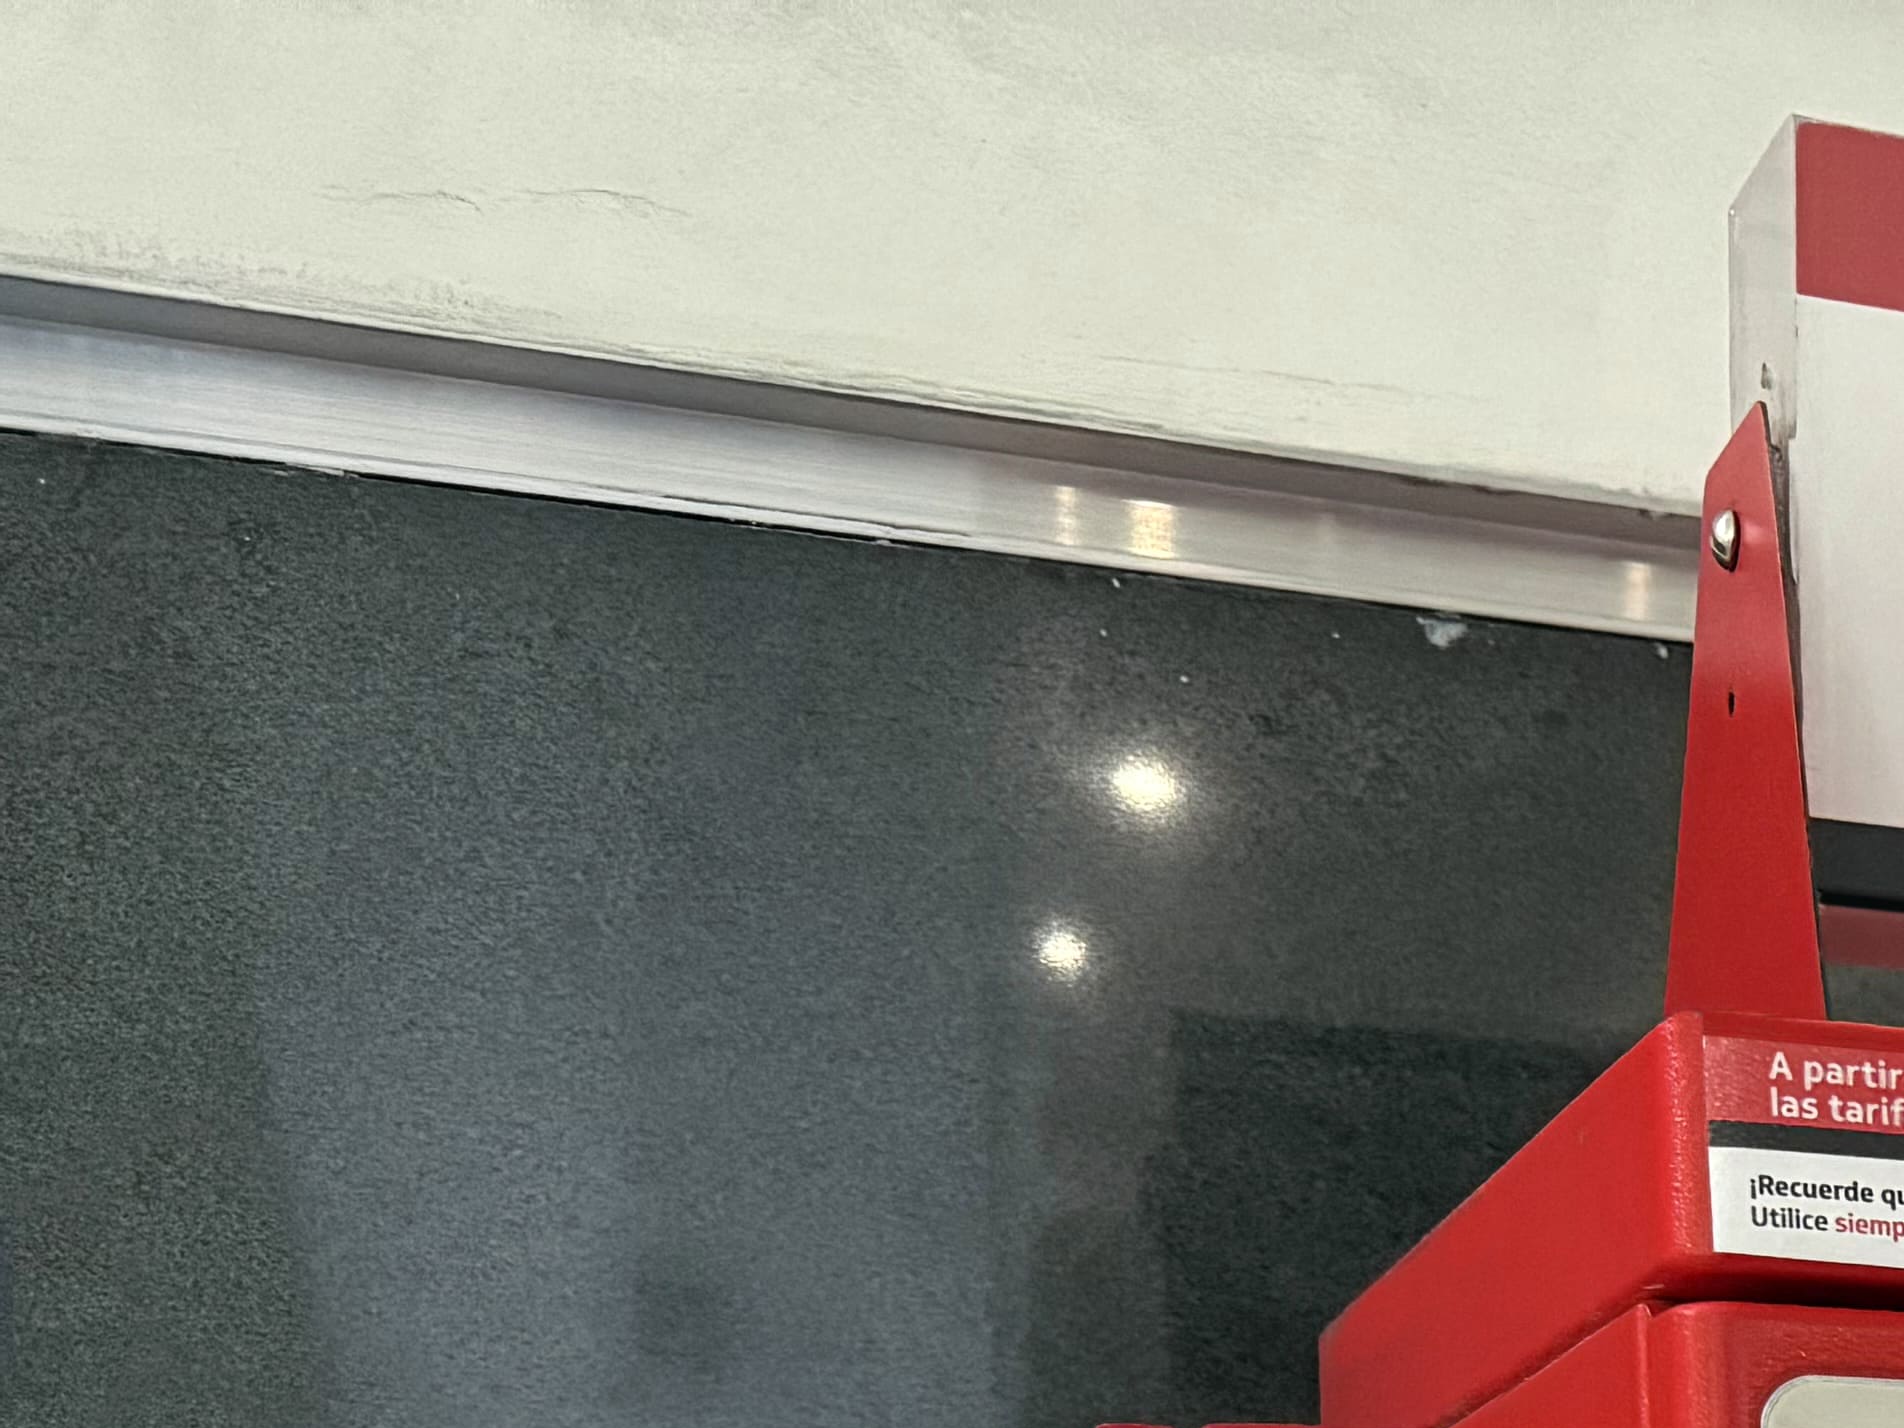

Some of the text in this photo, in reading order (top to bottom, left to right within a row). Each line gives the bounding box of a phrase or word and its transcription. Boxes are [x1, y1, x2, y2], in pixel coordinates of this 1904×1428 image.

[1769, 1052, 1792, 1080] A
[1804, 1060, 1902, 1089] partir
[1771, 1088, 1818, 1119] las
[1751, 1175, 1873, 1202] ¡Recuerde
[1752, 1206, 1828, 1231] Utilice
